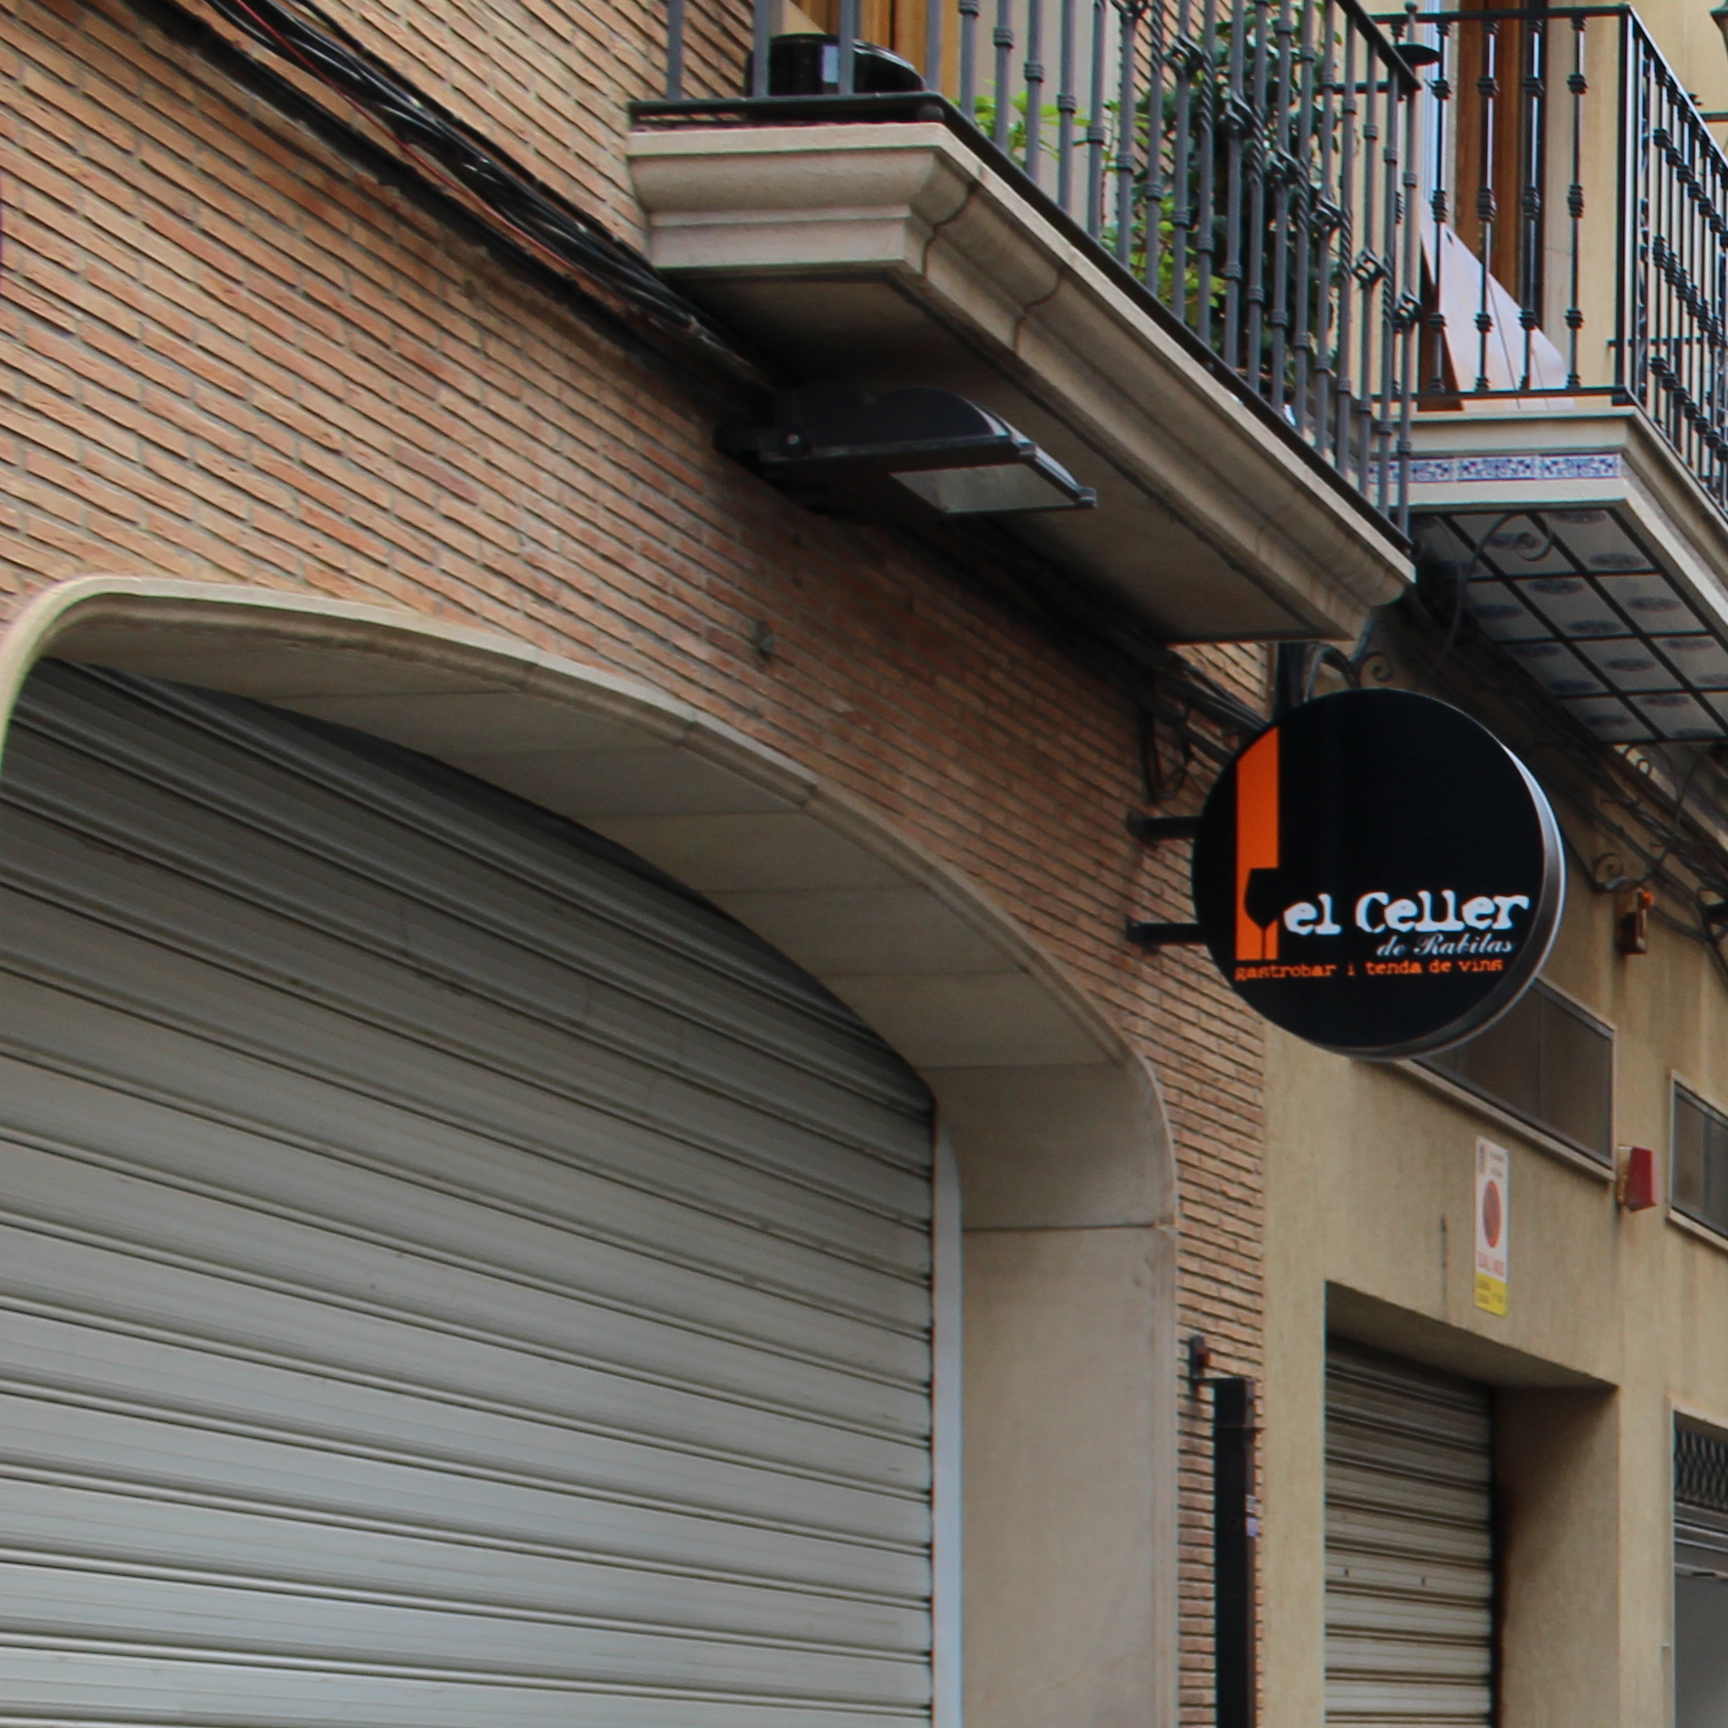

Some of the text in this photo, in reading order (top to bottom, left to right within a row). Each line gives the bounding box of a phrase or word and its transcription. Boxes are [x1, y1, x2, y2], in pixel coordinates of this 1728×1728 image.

[1283, 890, 1530, 935] el Celler
[1234, 957, 1504, 981] gastrobar i tenda de vins
